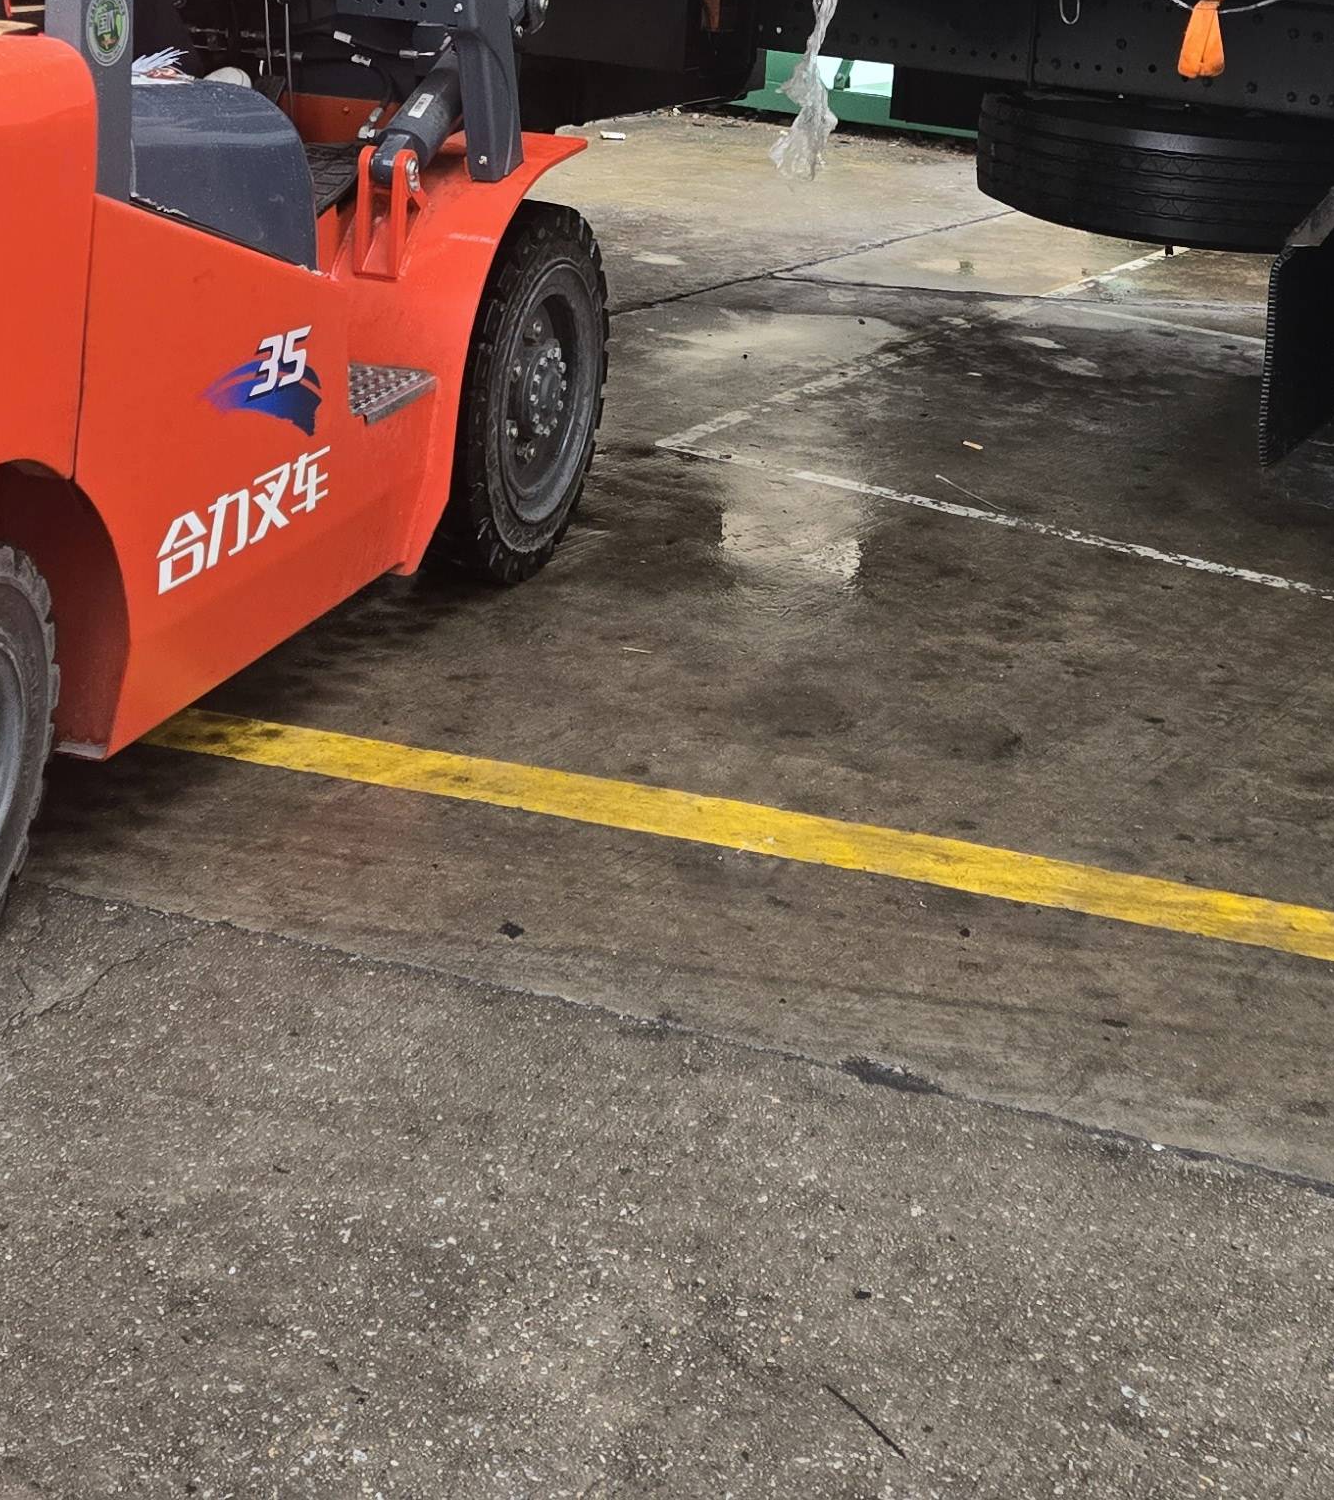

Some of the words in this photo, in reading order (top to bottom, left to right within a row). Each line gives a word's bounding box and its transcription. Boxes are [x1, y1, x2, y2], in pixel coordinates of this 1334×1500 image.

[249, 324, 312, 398] 35
[156, 445, 331, 596] 合力叉车
